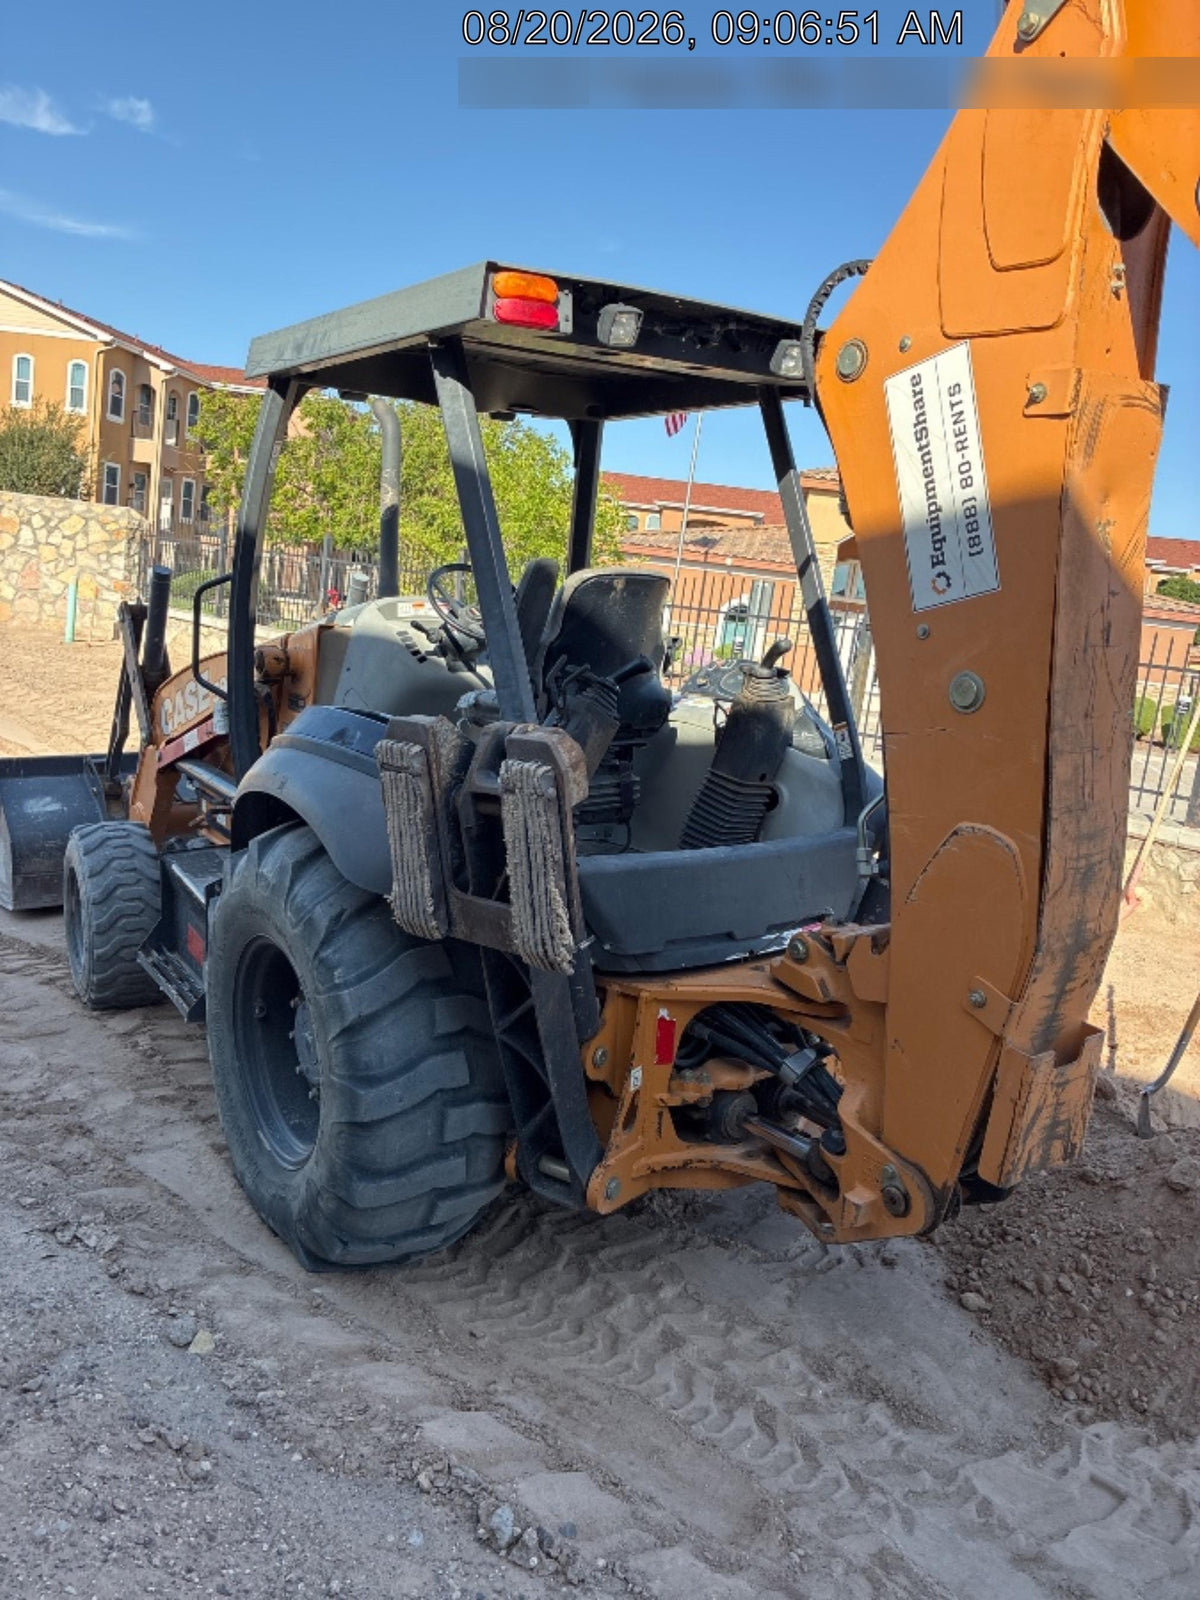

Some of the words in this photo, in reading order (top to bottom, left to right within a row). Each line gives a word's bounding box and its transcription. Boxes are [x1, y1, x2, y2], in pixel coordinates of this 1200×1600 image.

[910, 373, 946, 568] EquipmentShare
[947, 382, 974, 489] 80-RENTS
[962, 496, 984, 558] (888)
[161, 670, 211, 735] CASE
